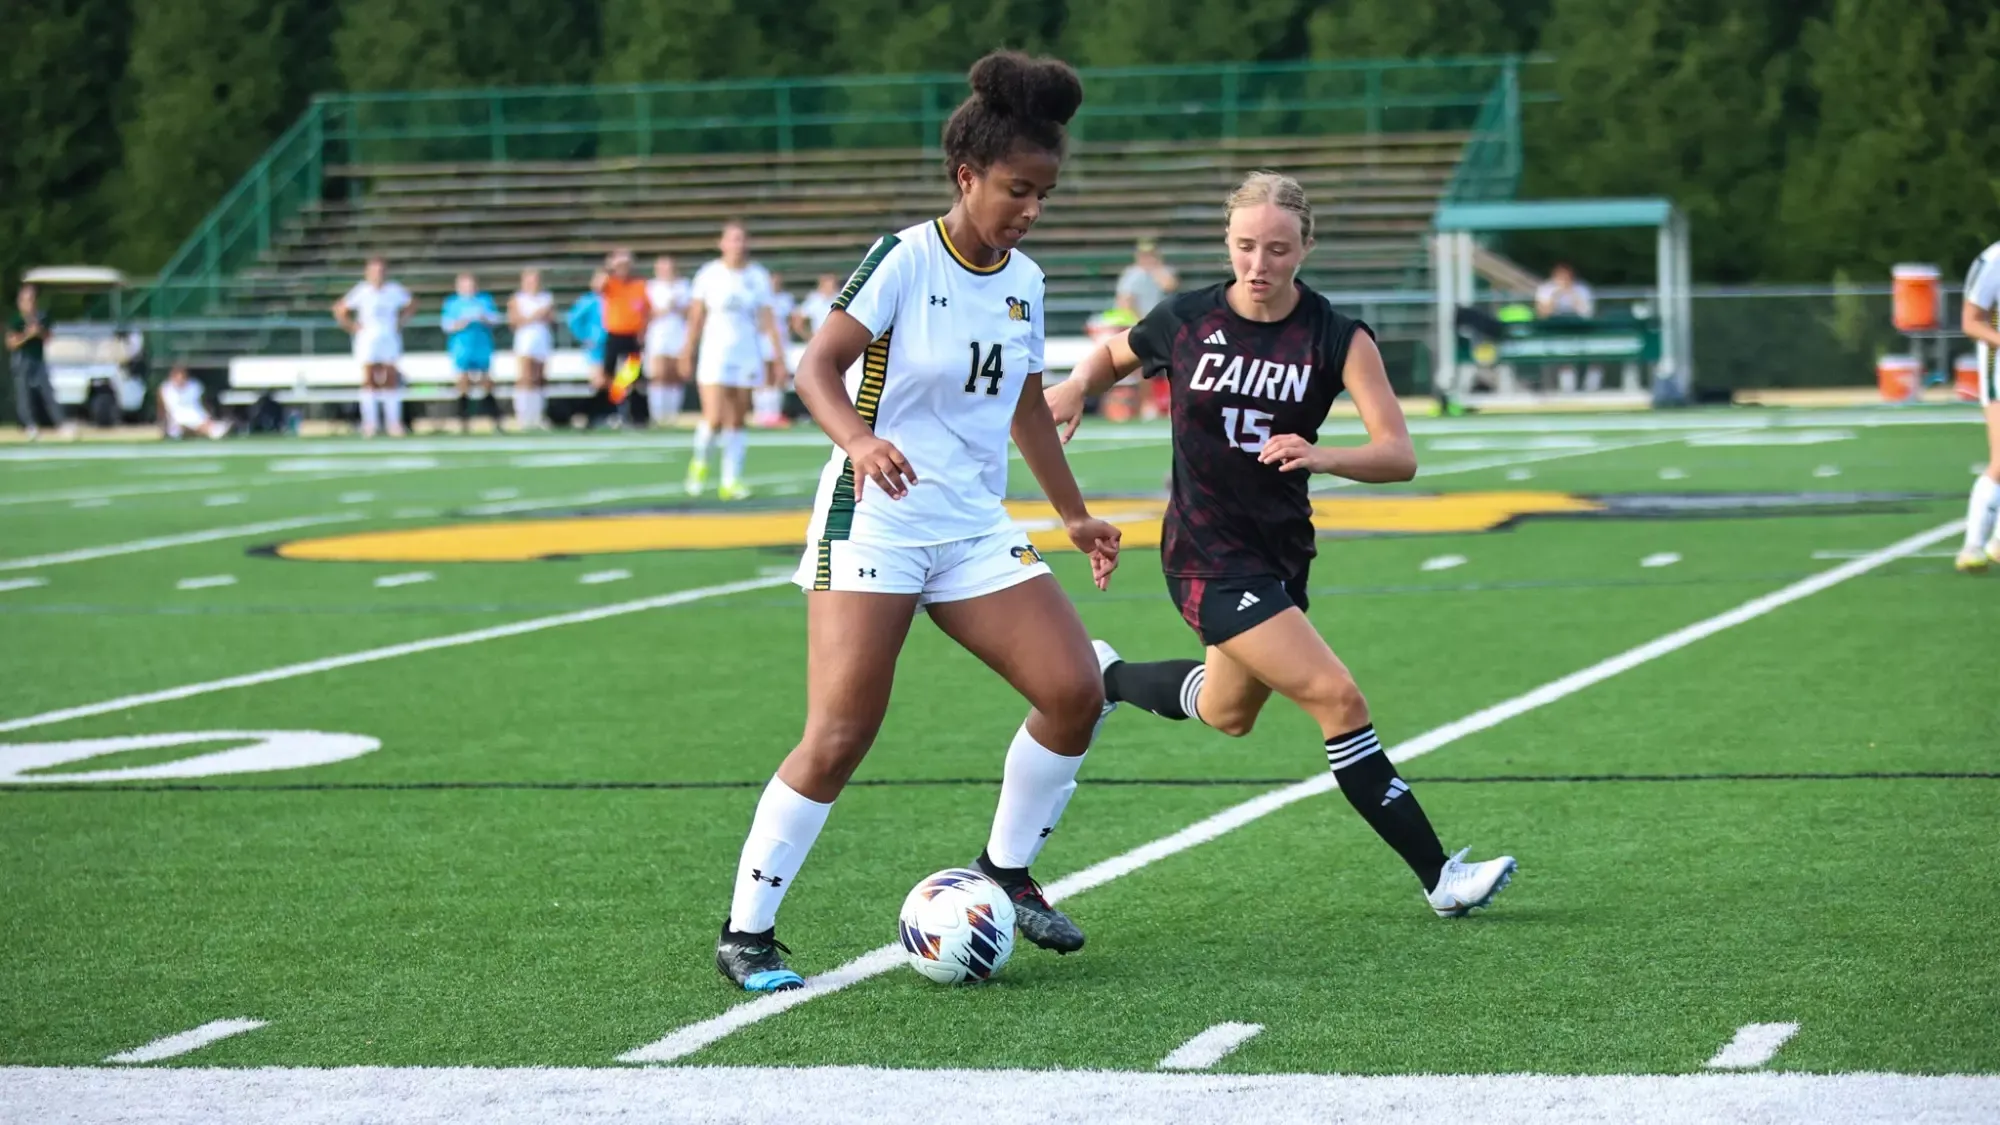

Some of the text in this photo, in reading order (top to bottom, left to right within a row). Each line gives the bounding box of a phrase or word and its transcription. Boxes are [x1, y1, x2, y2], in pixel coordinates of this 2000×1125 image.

[964, 340, 1004, 396] 14
[1189, 352, 1312, 402] CAIRN
[1221, 406, 1275, 453] 15
